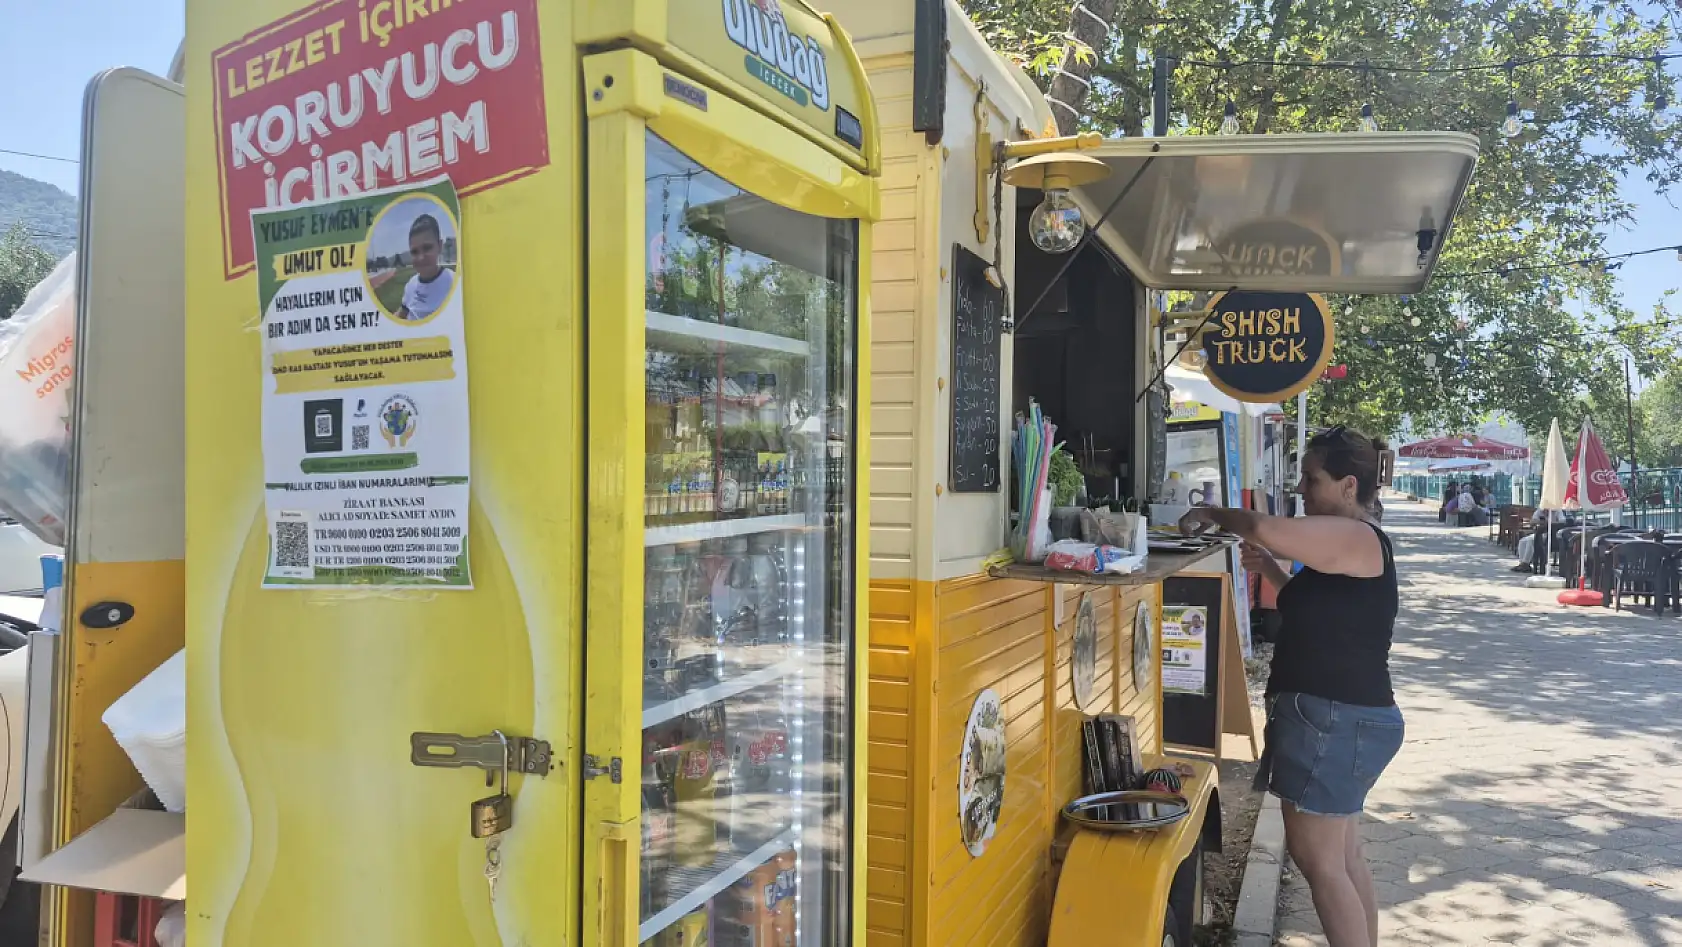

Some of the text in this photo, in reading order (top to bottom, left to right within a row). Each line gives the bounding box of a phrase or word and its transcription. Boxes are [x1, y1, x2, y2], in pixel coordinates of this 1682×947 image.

[227, 19, 346, 98] LEZZET
[230, 10, 519, 169] KORUYUCU
[260, 215, 306, 243] YUSUF
[283, 244, 356, 275] UMUT OL!
[287, 317, 312, 335] ADIM
[316, 315, 331, 332] DA
[360, 310, 380, 328] AT!
[1221, 307, 1301, 338] SHISH
[16, 336, 73, 384] Migros
[1211, 337, 1309, 365] TRUCK
[982, 462, 995, 487] 20
[379, 496, 425, 507] BANKASI
[391, 509, 428, 520] SAMET
[314, 528, 328, 541] TR
[369, 527, 395, 539] 0203
[396, 526, 420, 538] 2506
[420, 526, 440, 538] 8041
